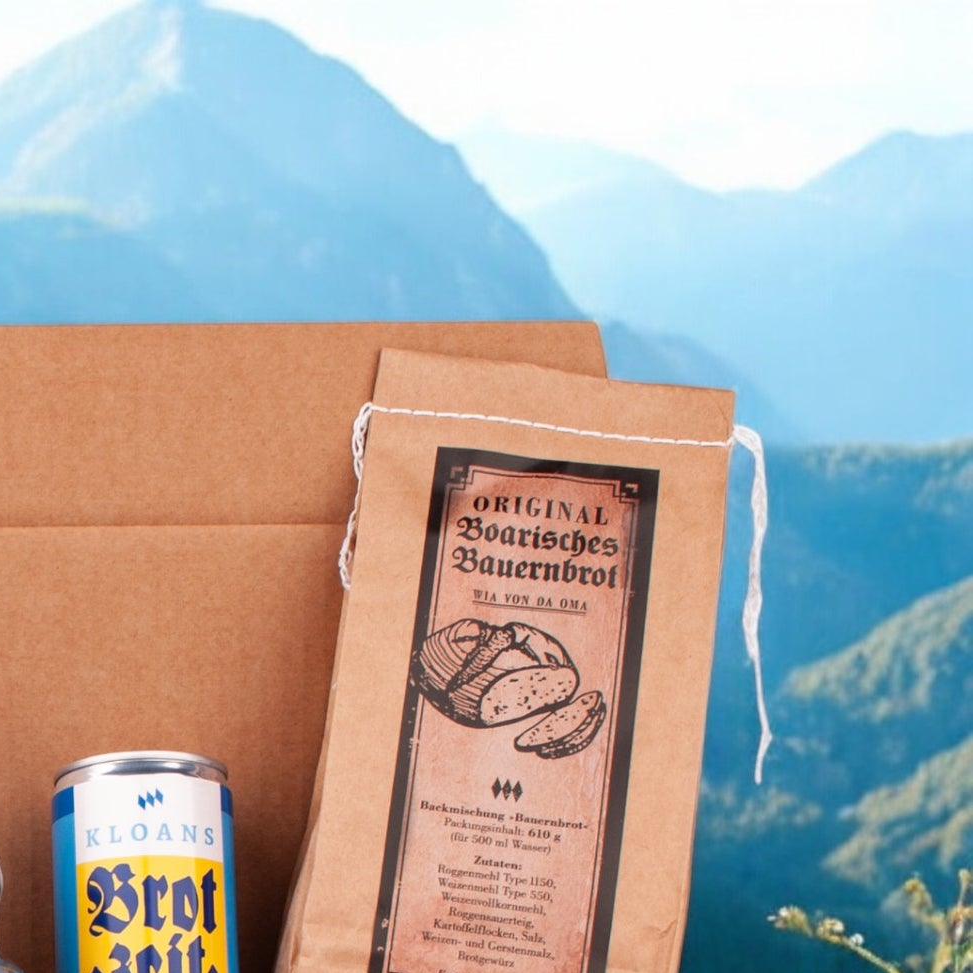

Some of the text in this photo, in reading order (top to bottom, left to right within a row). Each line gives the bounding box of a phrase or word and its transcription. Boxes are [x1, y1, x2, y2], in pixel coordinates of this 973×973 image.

[473, 495, 609, 526] ORIGINAL
[456, 516, 619, 557] Boarisches
[451, 546, 618, 589] Bauernbrot
[473, 588, 588, 612] WIA VON DA OMA
[420, 800, 505, 822] Backmischung
[85, 822, 215, 848] KLOANS
[444, 817, 563, 842] Packungsinhalt: 610 g
[450, 832, 552, 855] (für 500 ml Wasser)
[437, 864, 500, 882] Roggenmehl
[503, 872, 528, 885] Type
[473, 855, 523, 871] Zutaten:
[86, 863, 217, 938] Brot
[438, 877, 554, 903] Weizenmehl Type 550,
[441, 891, 547, 916] Weizenvollkornmehl,
[448, 906, 535, 929] Roggensauerteig,
[422, 931, 462, 946] Weizen-
[465, 938, 485, 949] und
[433, 918, 546, 944] Kartoffelflocken, Salz,
[458, 951, 515, 968] Brotgewürz
